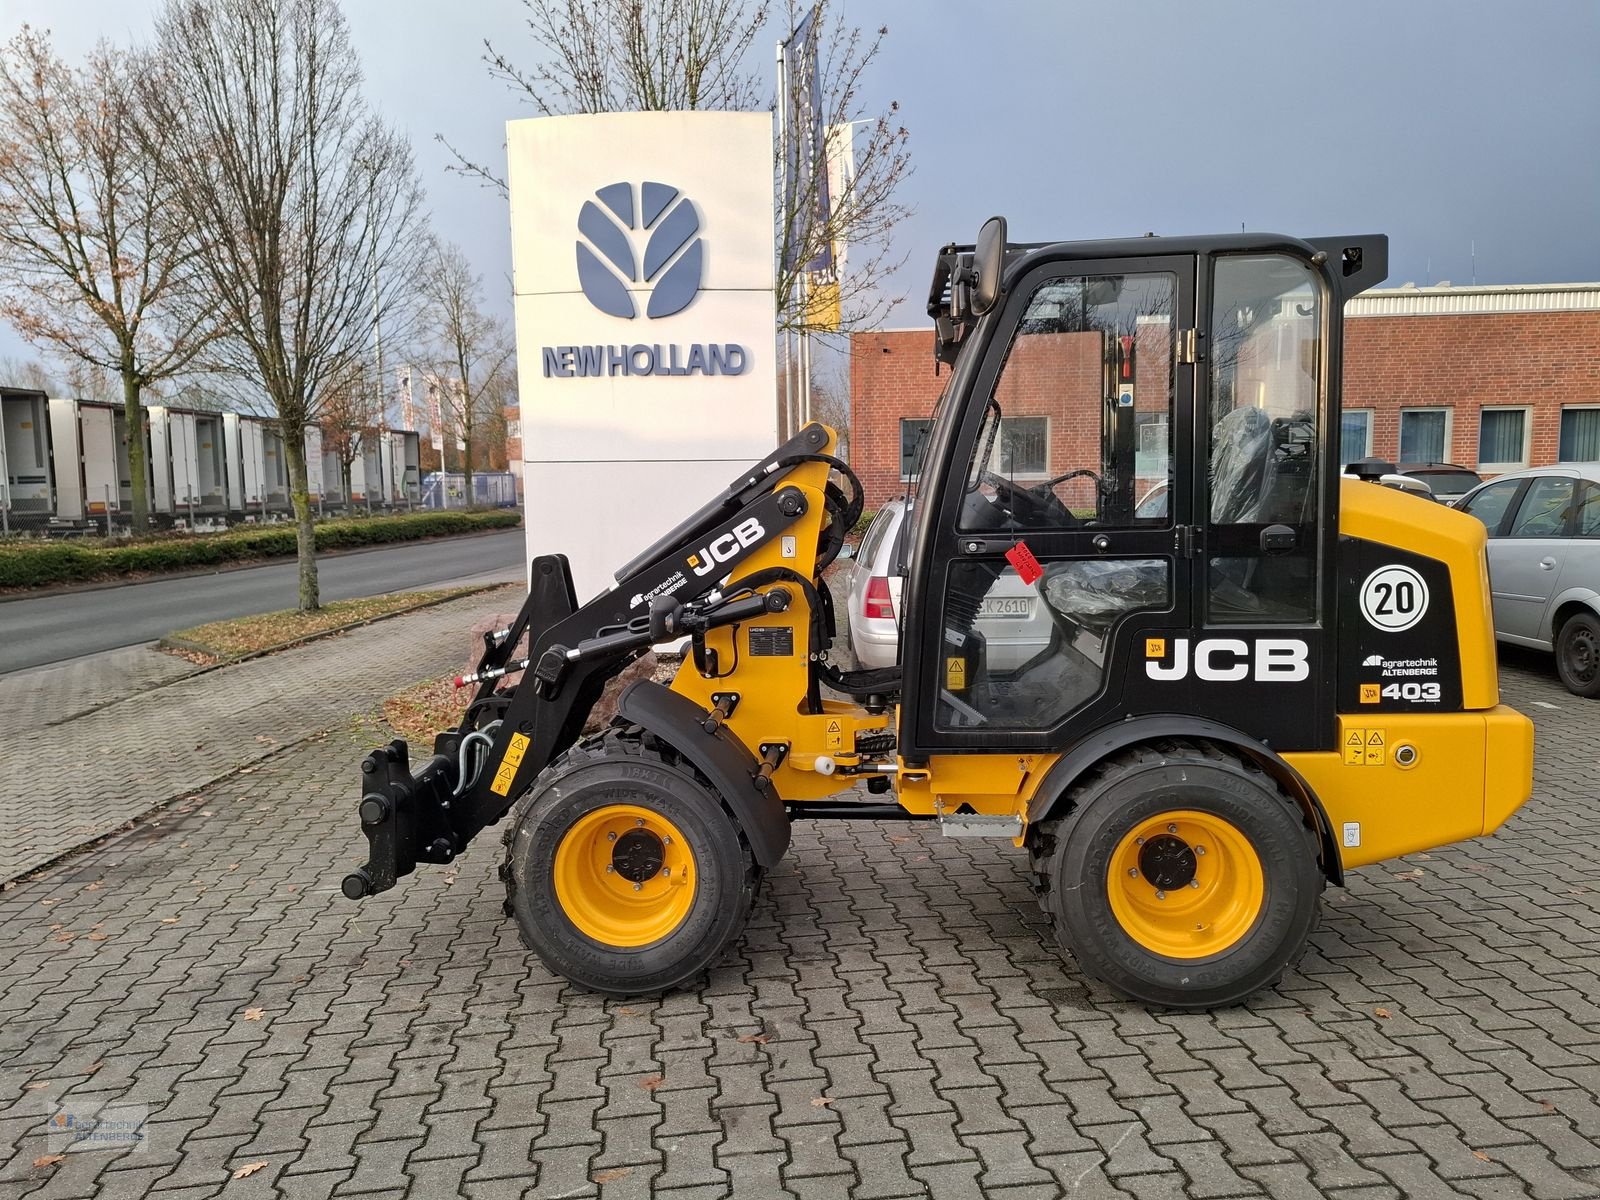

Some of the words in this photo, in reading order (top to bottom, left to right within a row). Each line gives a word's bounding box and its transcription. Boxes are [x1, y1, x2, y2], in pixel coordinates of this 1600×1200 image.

[542, 345, 602, 377] NEW
[606, 343, 746, 376] HOLLAND
[693, 517, 766, 577] JCB
[643, 571, 684, 601] agrartechnik
[648, 576, 688, 608] ANBERGE
[1374, 581, 1415, 615] 20
[996, 600, 1027, 613] 2610
[1145, 638, 1310, 682] JCB
[1381, 667, 1438, 677] ALTENBERGE
[1382, 657, 1438, 669] agrartechnik
[1381, 682, 1441, 700] 403
